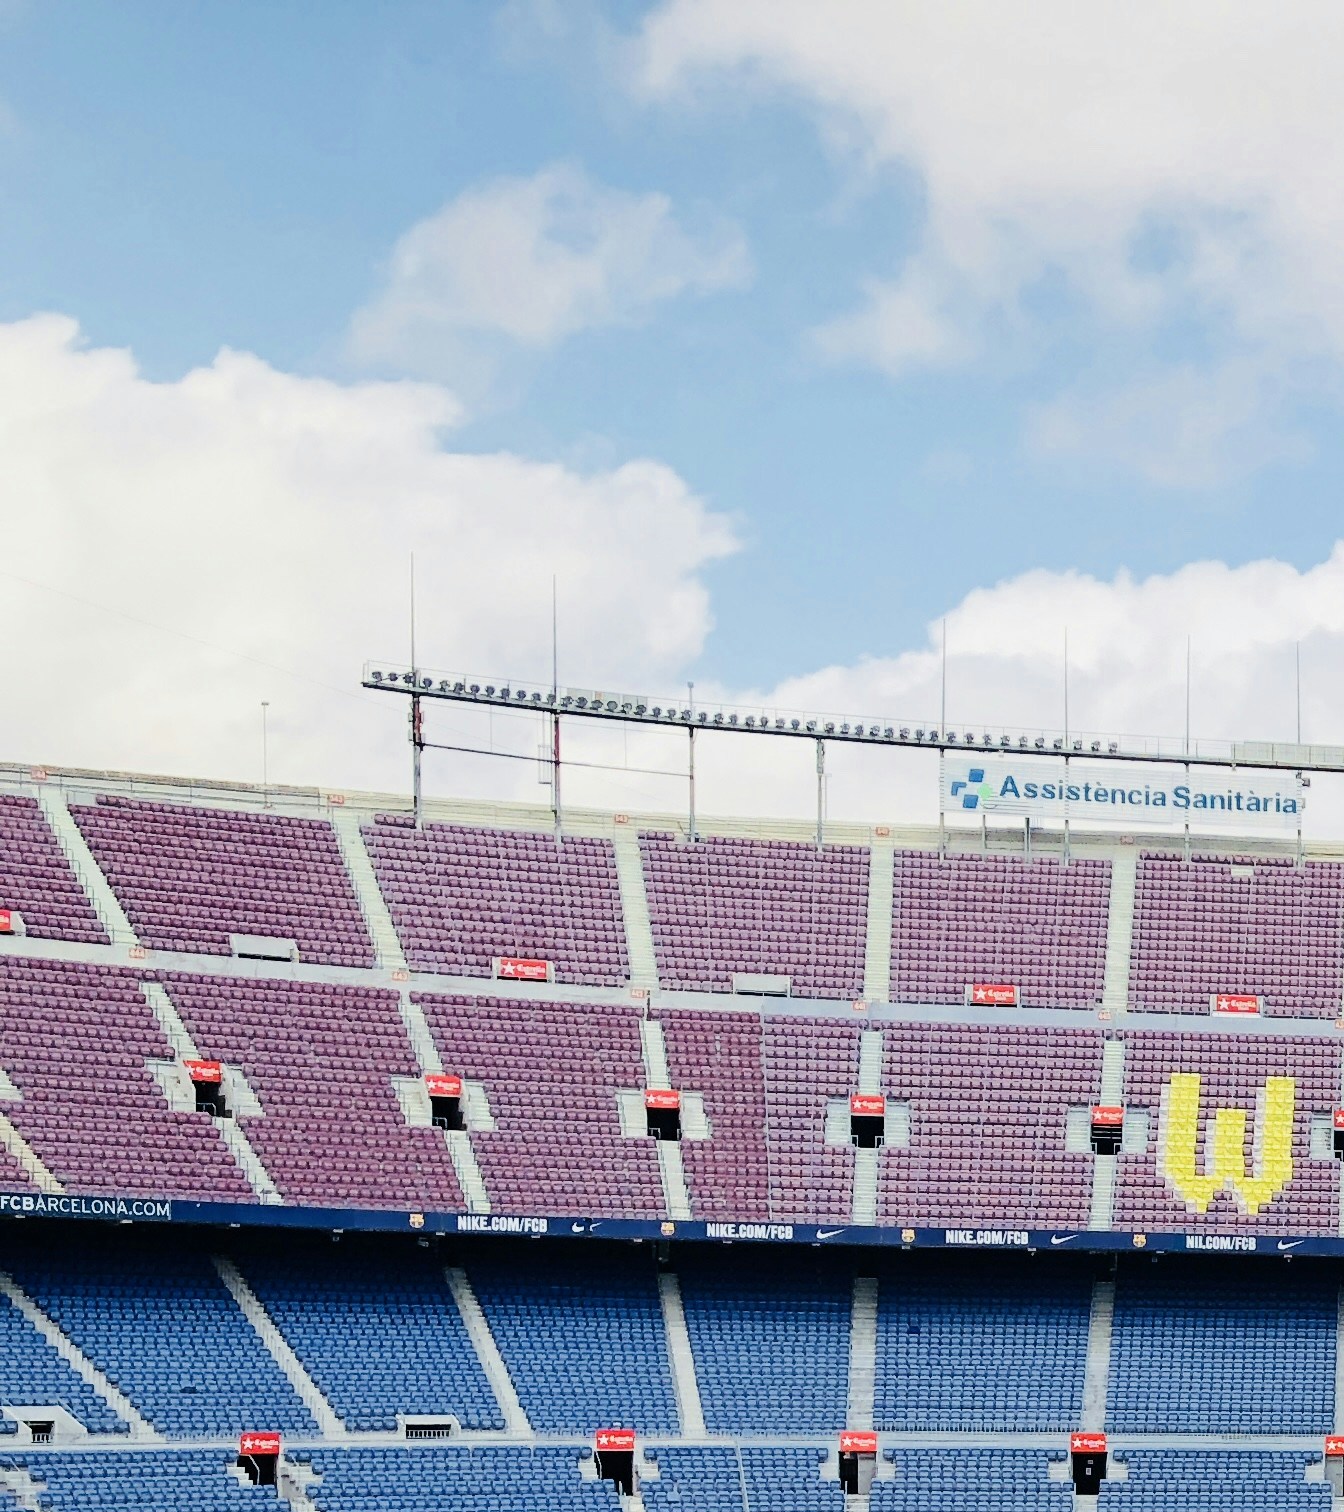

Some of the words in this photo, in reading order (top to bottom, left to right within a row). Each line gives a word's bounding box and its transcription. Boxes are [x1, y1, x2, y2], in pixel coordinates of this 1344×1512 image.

[999, 775, 1166, 807] Assistència
[1172, 785, 1298, 815] Sanitària
[0, 1195, 170, 1220] FCBARCELONA.COM
[457, 1215, 548, 1233] NIKE.COM/FCB
[706, 1223, 794, 1239] NIKE.COM/FCB
[945, 1230, 1029, 1245] NIKE.COM/FCB
